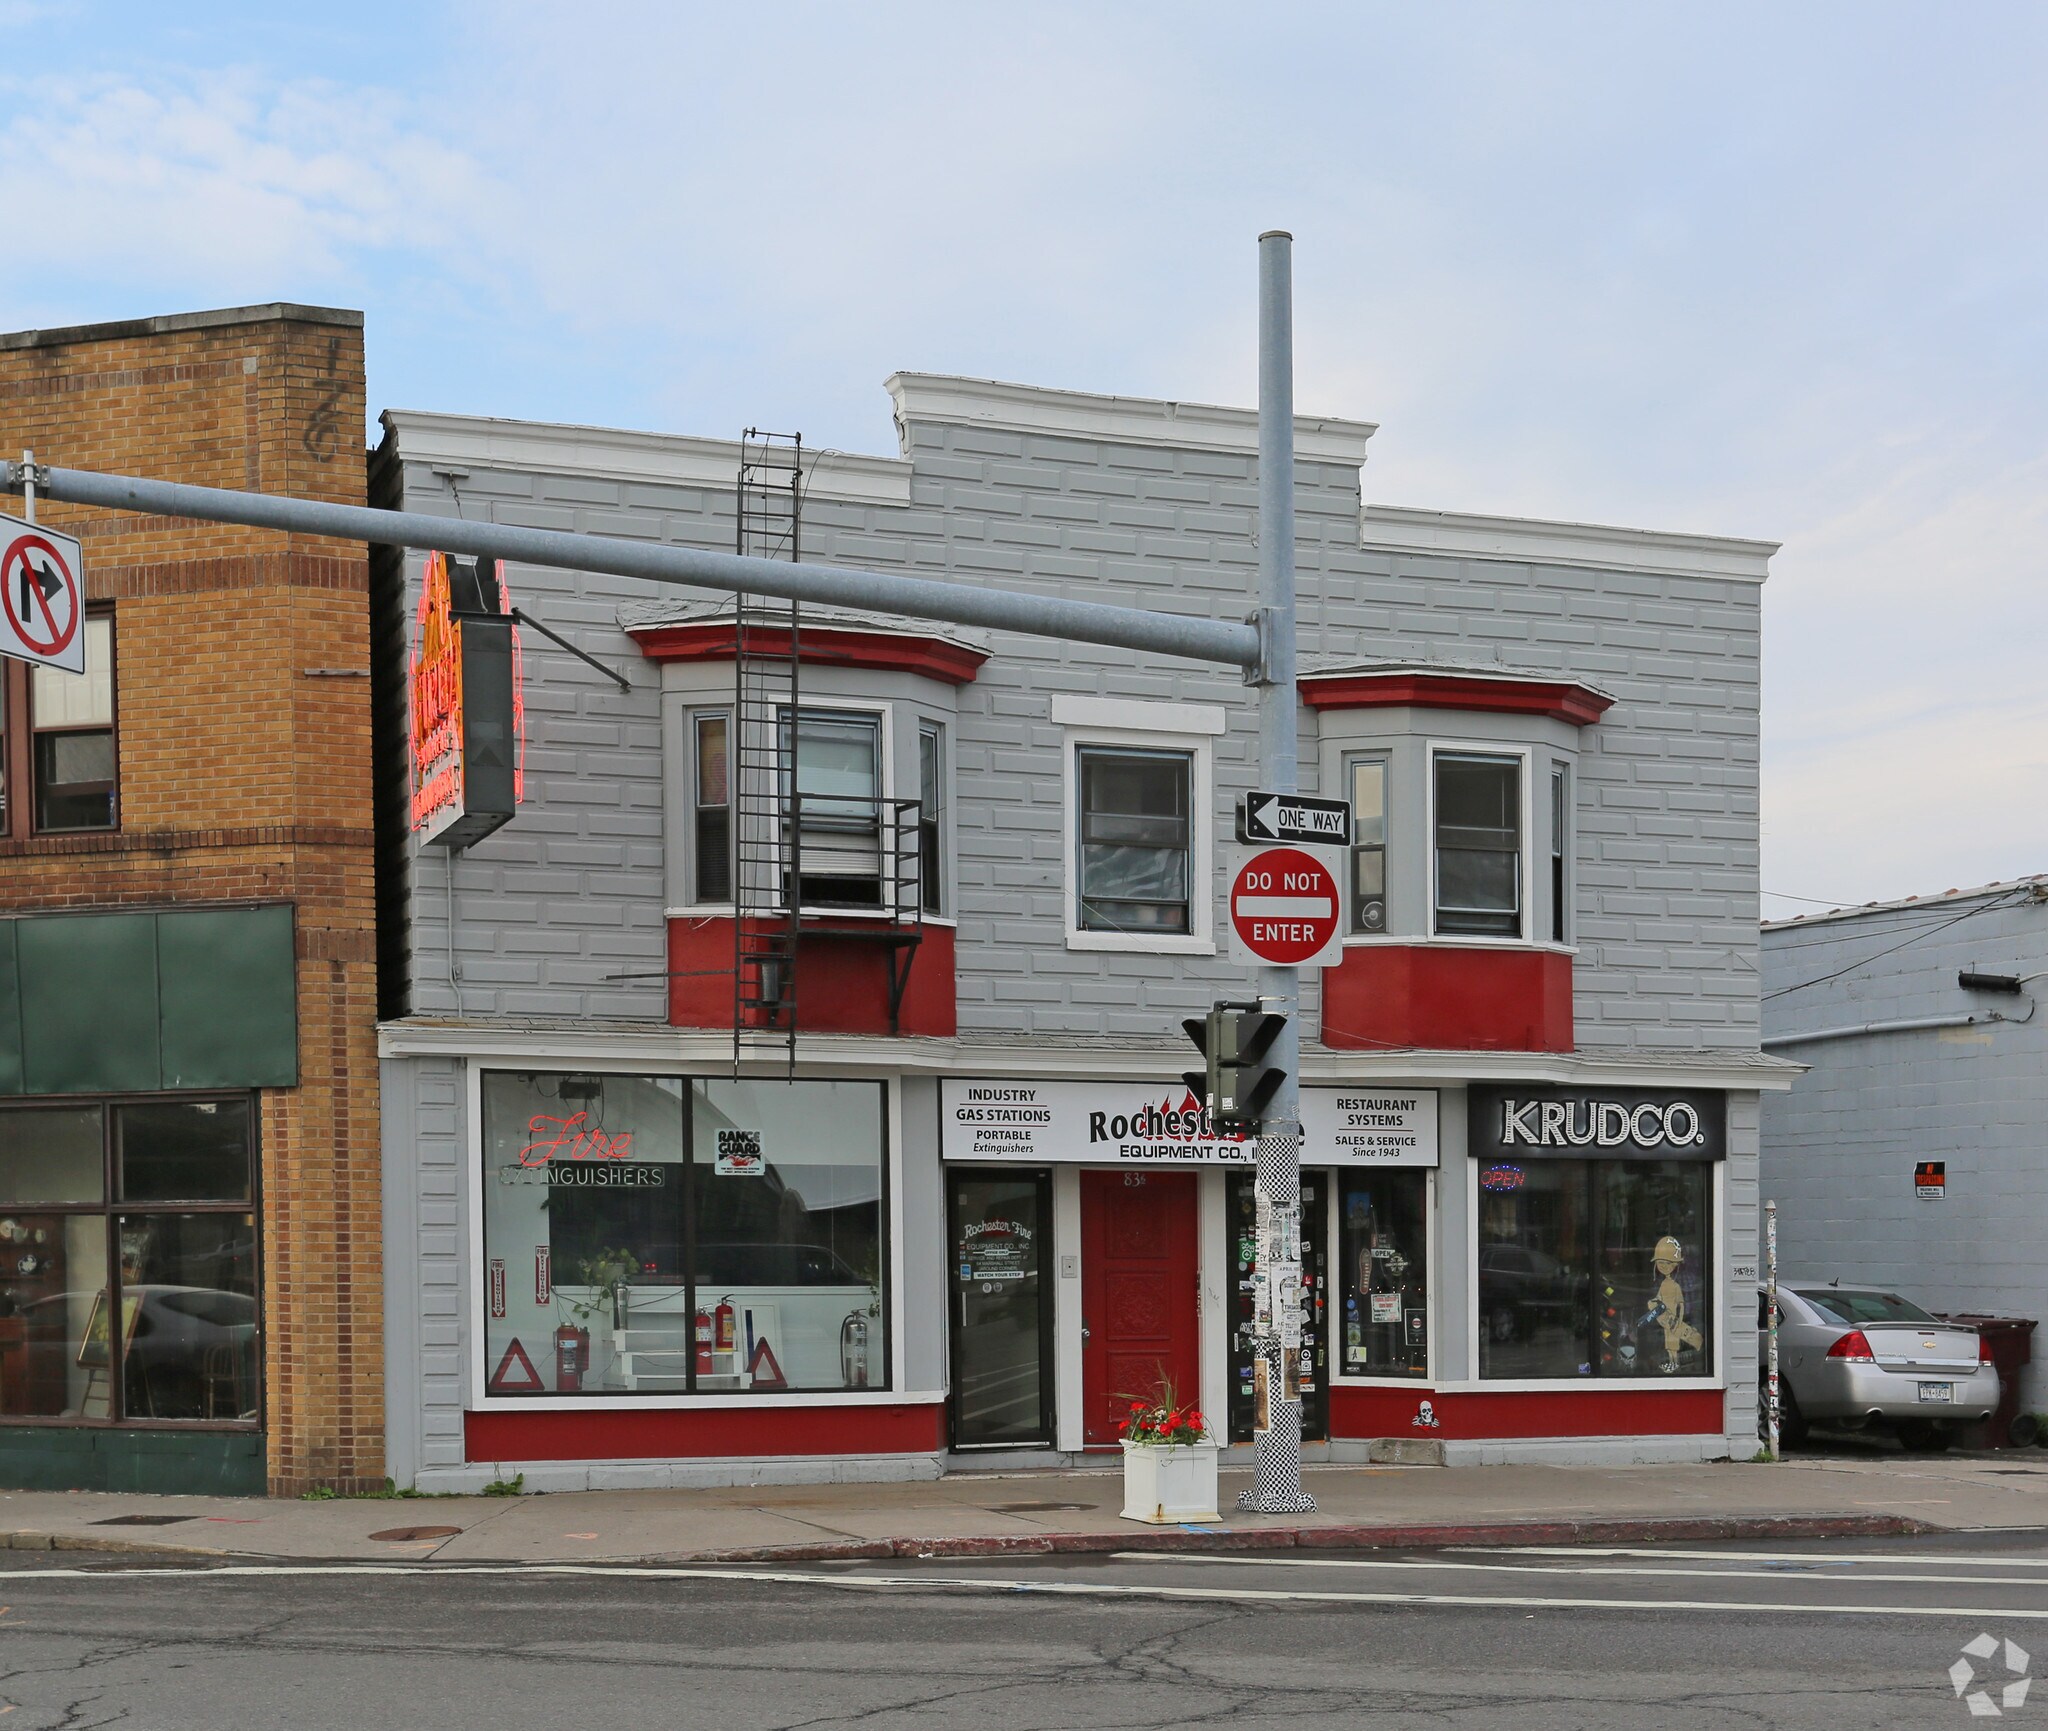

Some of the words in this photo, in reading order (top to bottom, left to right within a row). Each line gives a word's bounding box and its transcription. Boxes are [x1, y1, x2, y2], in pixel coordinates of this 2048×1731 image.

[1278, 809, 1306, 828] ONE
[1313, 812, 1342, 831] WAY
[1246, 872, 1272, 890] DO
[1284, 873, 1321, 891] NOT
[1253, 923, 1315, 942] ENTER
[968, 1088, 1037, 1101] INDUSTRY
[1336, 1098, 1417, 1111] RESTAURANT
[956, 1109, 984, 1121] GAS
[987, 1109, 1051, 1122] STATIONS
[1347, 1114, 1403, 1126] SYSTEMS
[1089, 1105, 1237, 1143] Rochest
[1502, 1099, 1705, 1147] KRUDCO.
[519, 1111, 632, 1167] Fire
[718, 1130, 761, 1142] RANGE
[976, 1130, 1032, 1140] PORTABLE
[1335, 1135, 1365, 1146] SALES
[1367, 1136, 1375, 1146] &
[1376, 1136, 1416, 1146] SERVICE
[718, 1142, 761, 1154] GUARD
[973, 1142, 1034, 1155] Extinguishers
[1120, 1144, 1213, 1159] EQUIPMENT
[1218, 1146, 1248, 1162] CO.,
[1352, 1147, 1376, 1157] Since
[1379, 1148, 1400, 1157] 1943
[501, 1167, 663, 1185] EXTINGUISHERS
[1480, 1171, 1526, 1186] OPEN
[964, 1219, 1011, 1239] Rochester
[1011, 1221, 1032, 1240] Fire
